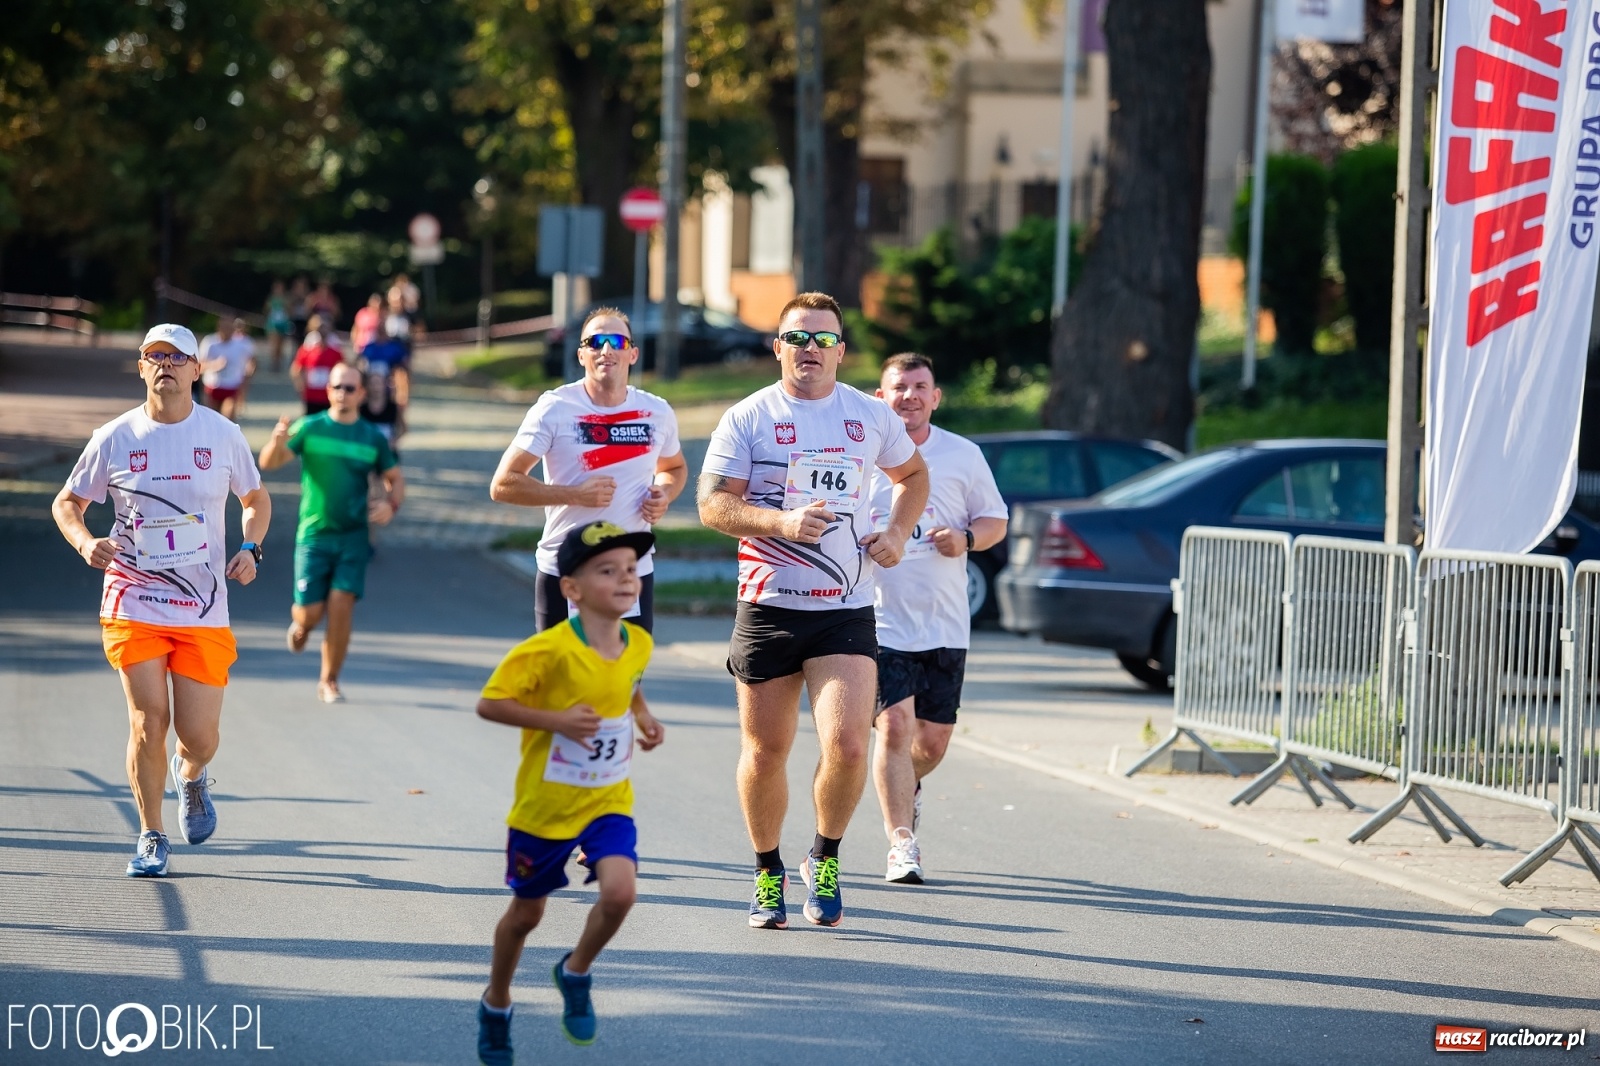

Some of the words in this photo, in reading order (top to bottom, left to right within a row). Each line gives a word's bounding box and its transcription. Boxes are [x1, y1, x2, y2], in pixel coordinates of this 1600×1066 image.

[1570, 115, 1600, 249] GRUPA
[610, 426, 646, 436] OSIEK
[810, 469, 847, 491] 146
[165, 529, 175, 551] 1
[588, 738, 617, 762] 33
